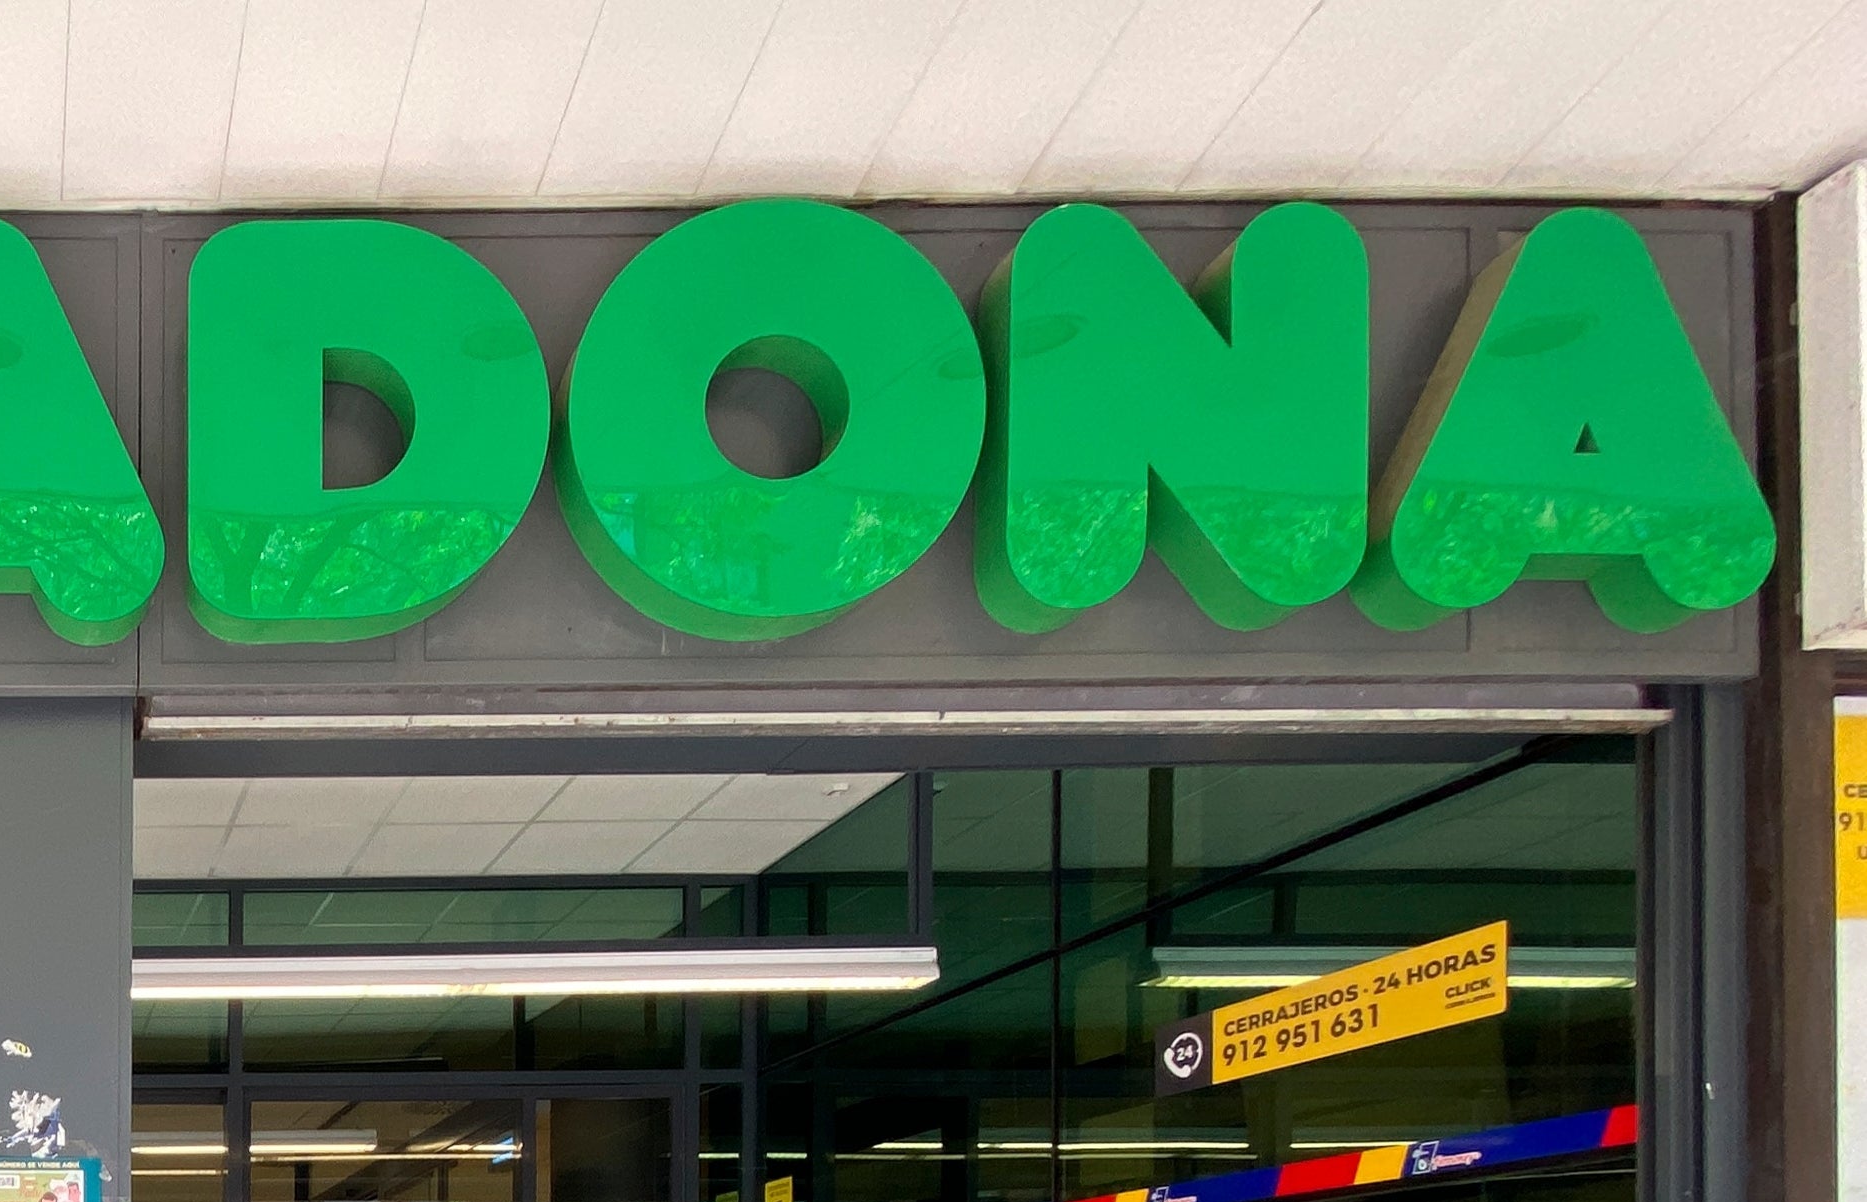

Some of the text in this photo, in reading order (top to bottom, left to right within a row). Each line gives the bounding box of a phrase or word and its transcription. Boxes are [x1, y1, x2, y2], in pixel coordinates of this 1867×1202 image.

[1223, 944, 1496, 1037] CERRAJEROS 24 HORAS
[1445, 976, 1491, 999] CLICK
[1222, 1003, 1379, 1066] 912 951 631
[1175, 1045, 1193, 1062] 24
[62, 1160, 80, 1168] AQUÍ
